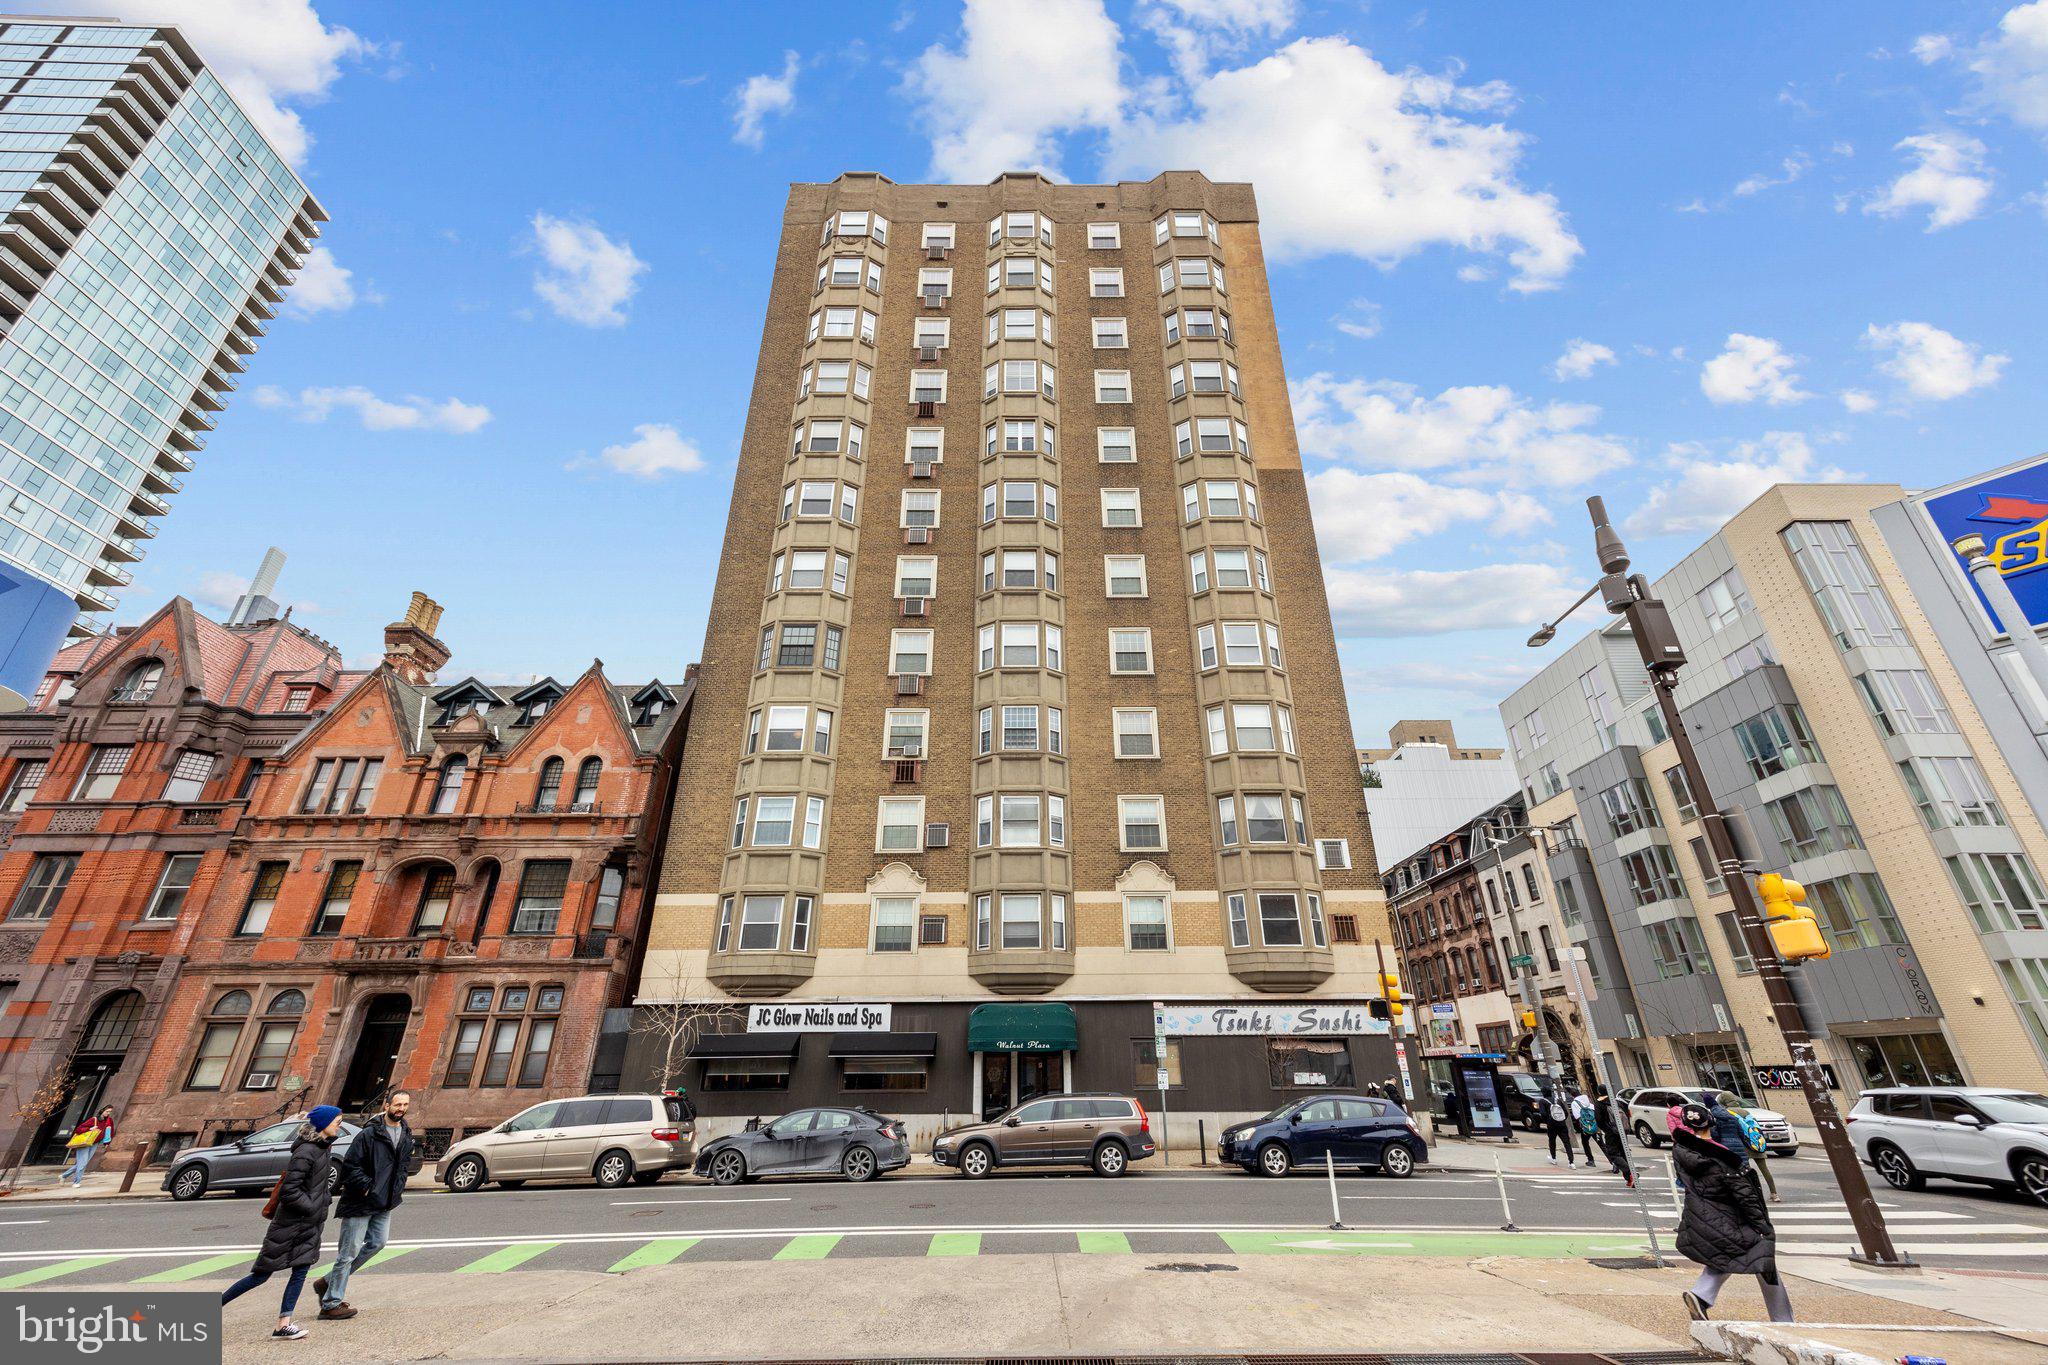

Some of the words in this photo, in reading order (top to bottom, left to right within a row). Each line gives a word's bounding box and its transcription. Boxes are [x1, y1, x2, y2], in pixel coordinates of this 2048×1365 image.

[756, 1008, 771, 1026] JC
[773, 1007, 802, 1026] Glow
[804, 1007, 834, 1026] Nails
[837, 1007, 858, 1026] and
[861, 1007, 882, 1029] Spa
[1212, 1008, 1272, 1033] Tsuki
[1292, 1008, 1362, 1033] Sushi
[996, 1040, 1024, 1049] Walnut
[1027, 1040, 1050, 1049] Plaza
